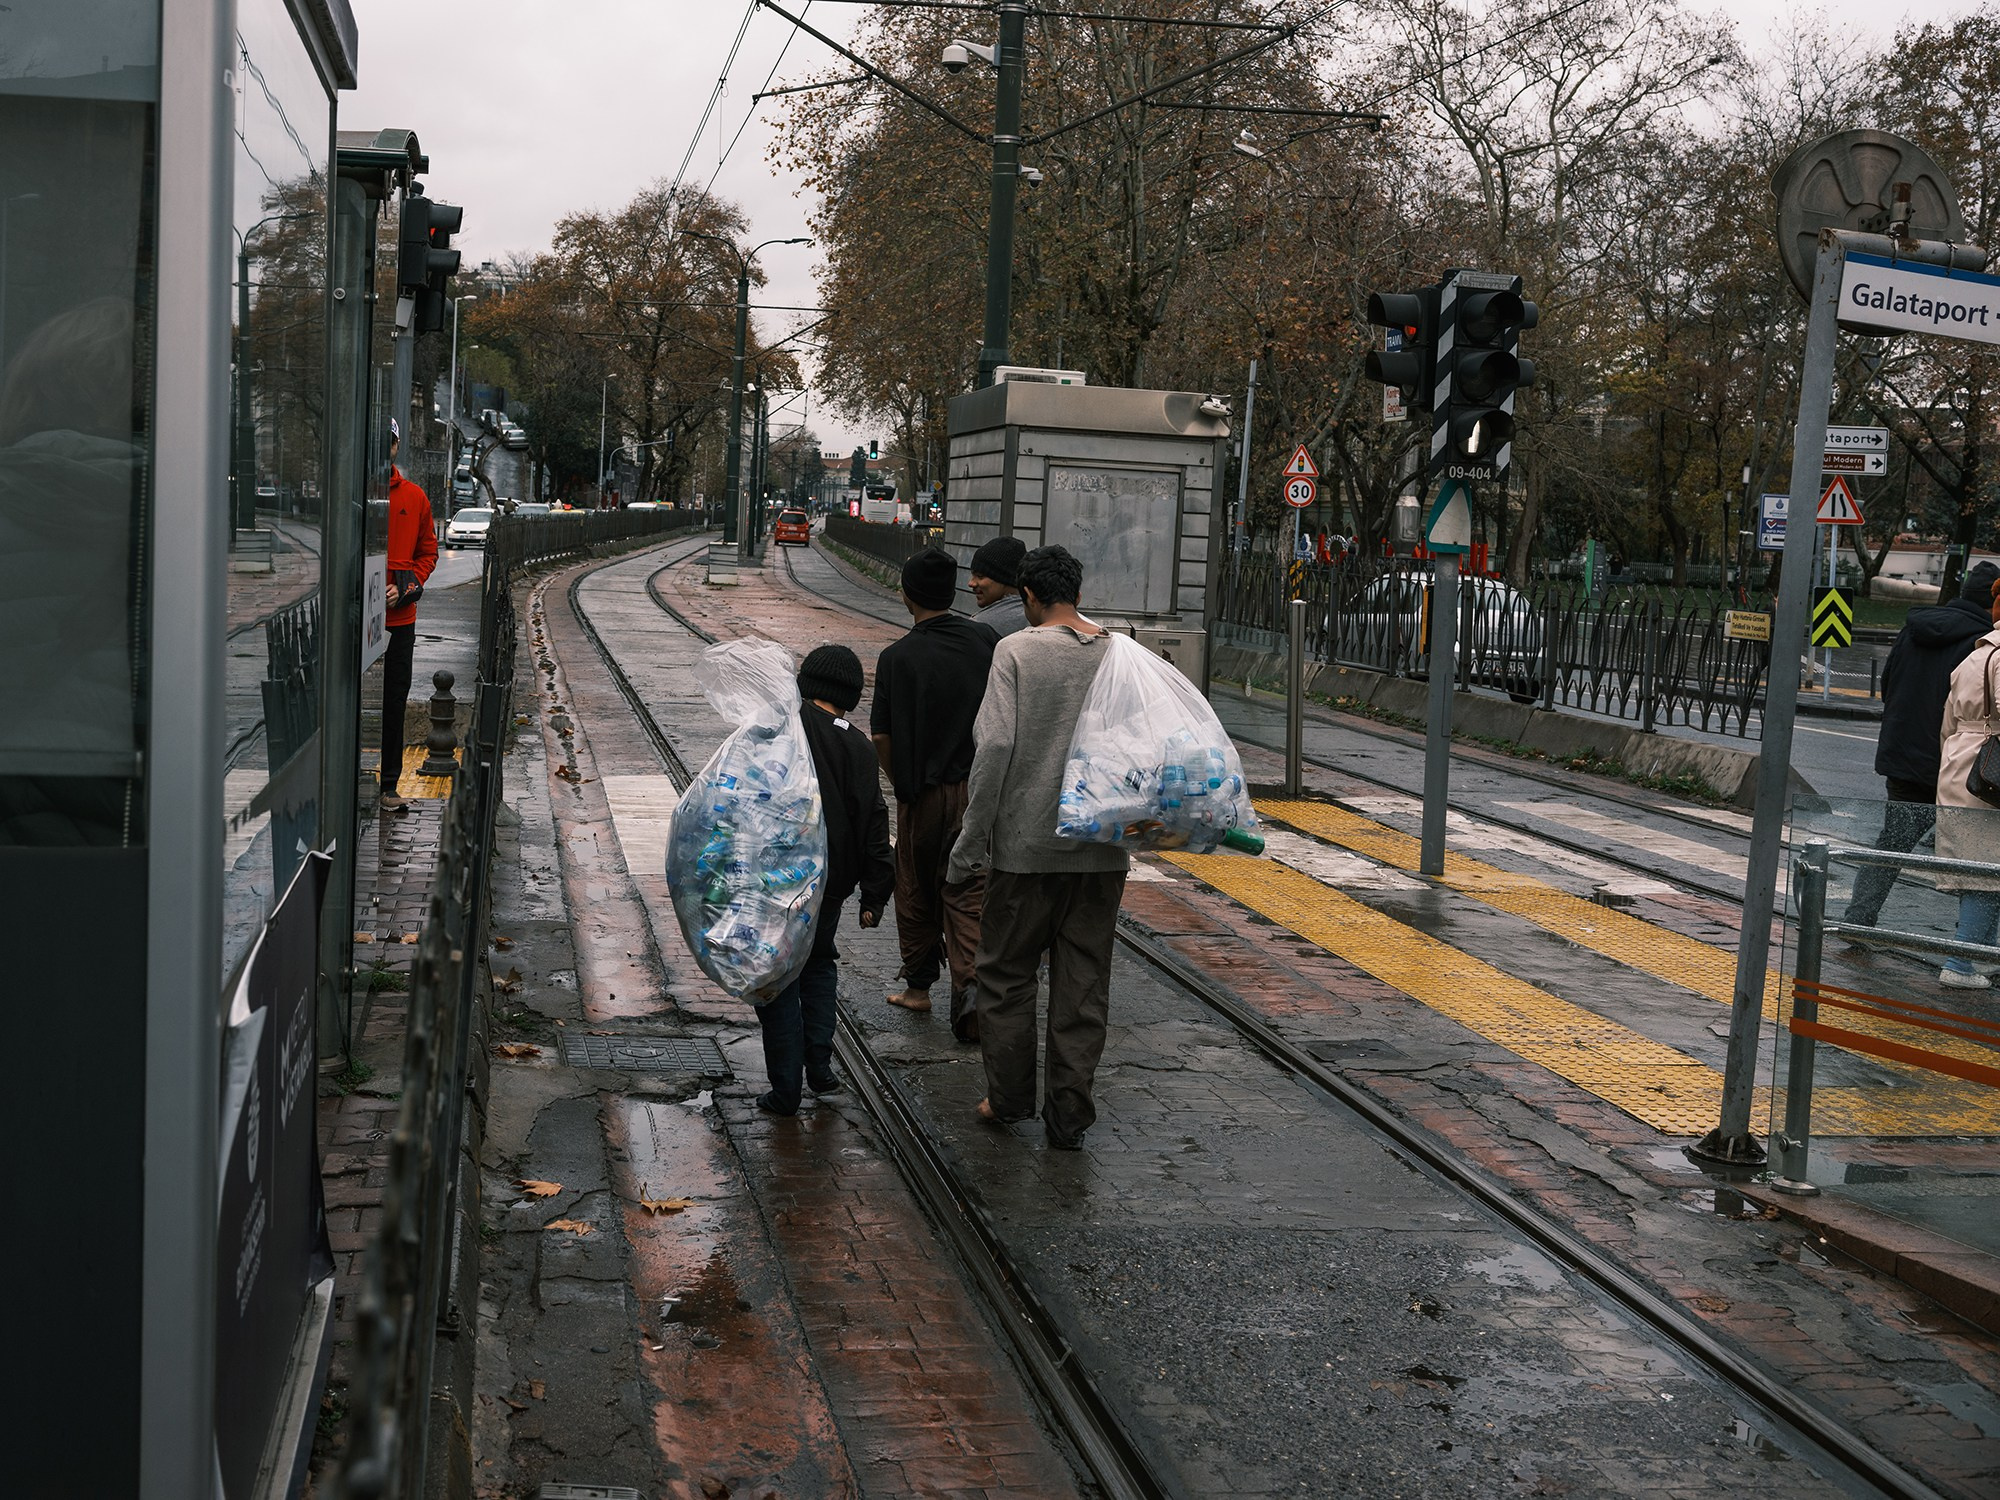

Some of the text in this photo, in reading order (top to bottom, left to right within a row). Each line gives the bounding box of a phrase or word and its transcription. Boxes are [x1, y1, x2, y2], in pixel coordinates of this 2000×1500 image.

[1852, 283, 1989, 326] Galataport
[1833, 456, 1863, 464] Modern
[1449, 466, 1491, 480] 09-404
[1291, 485, 1310, 498] 30
